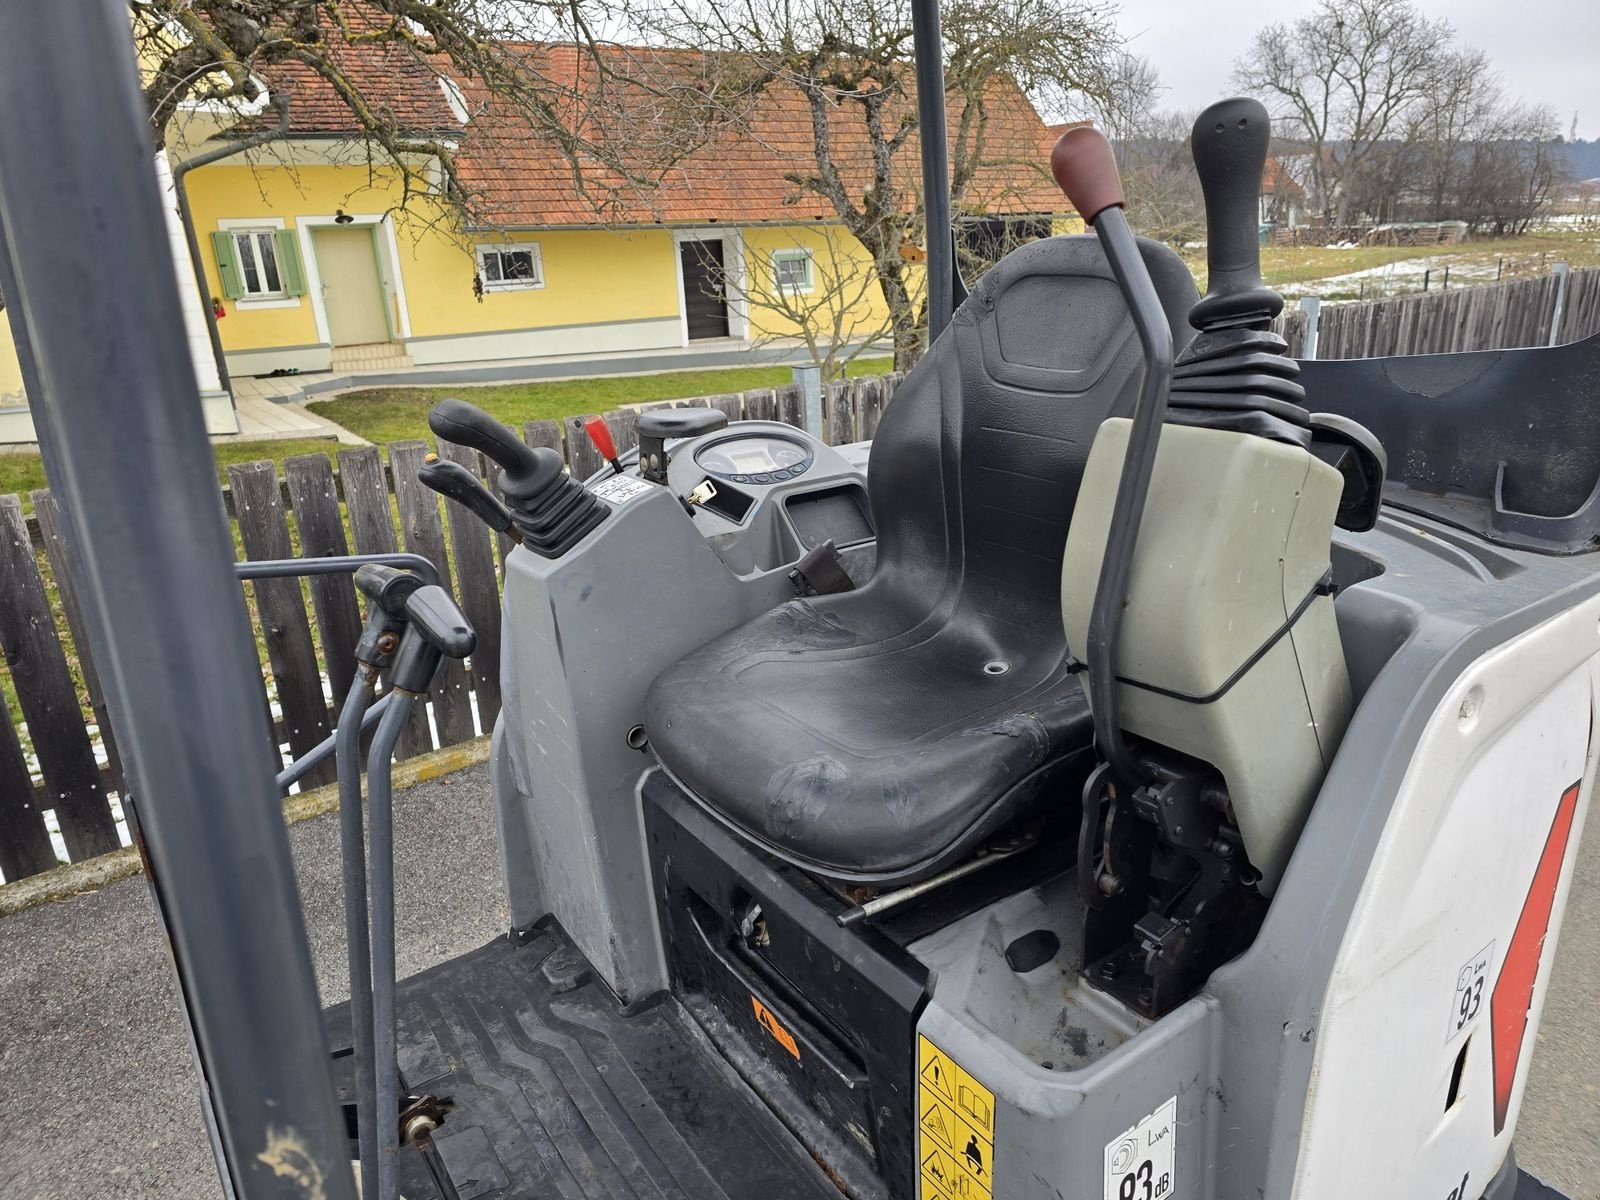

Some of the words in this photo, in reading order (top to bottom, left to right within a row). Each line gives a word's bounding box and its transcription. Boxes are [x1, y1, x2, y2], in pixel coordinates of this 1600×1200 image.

[1457, 976, 1484, 1030] 93
[1119, 1159, 1153, 1200] 93
[1154, 1172, 1169, 1199] dB
